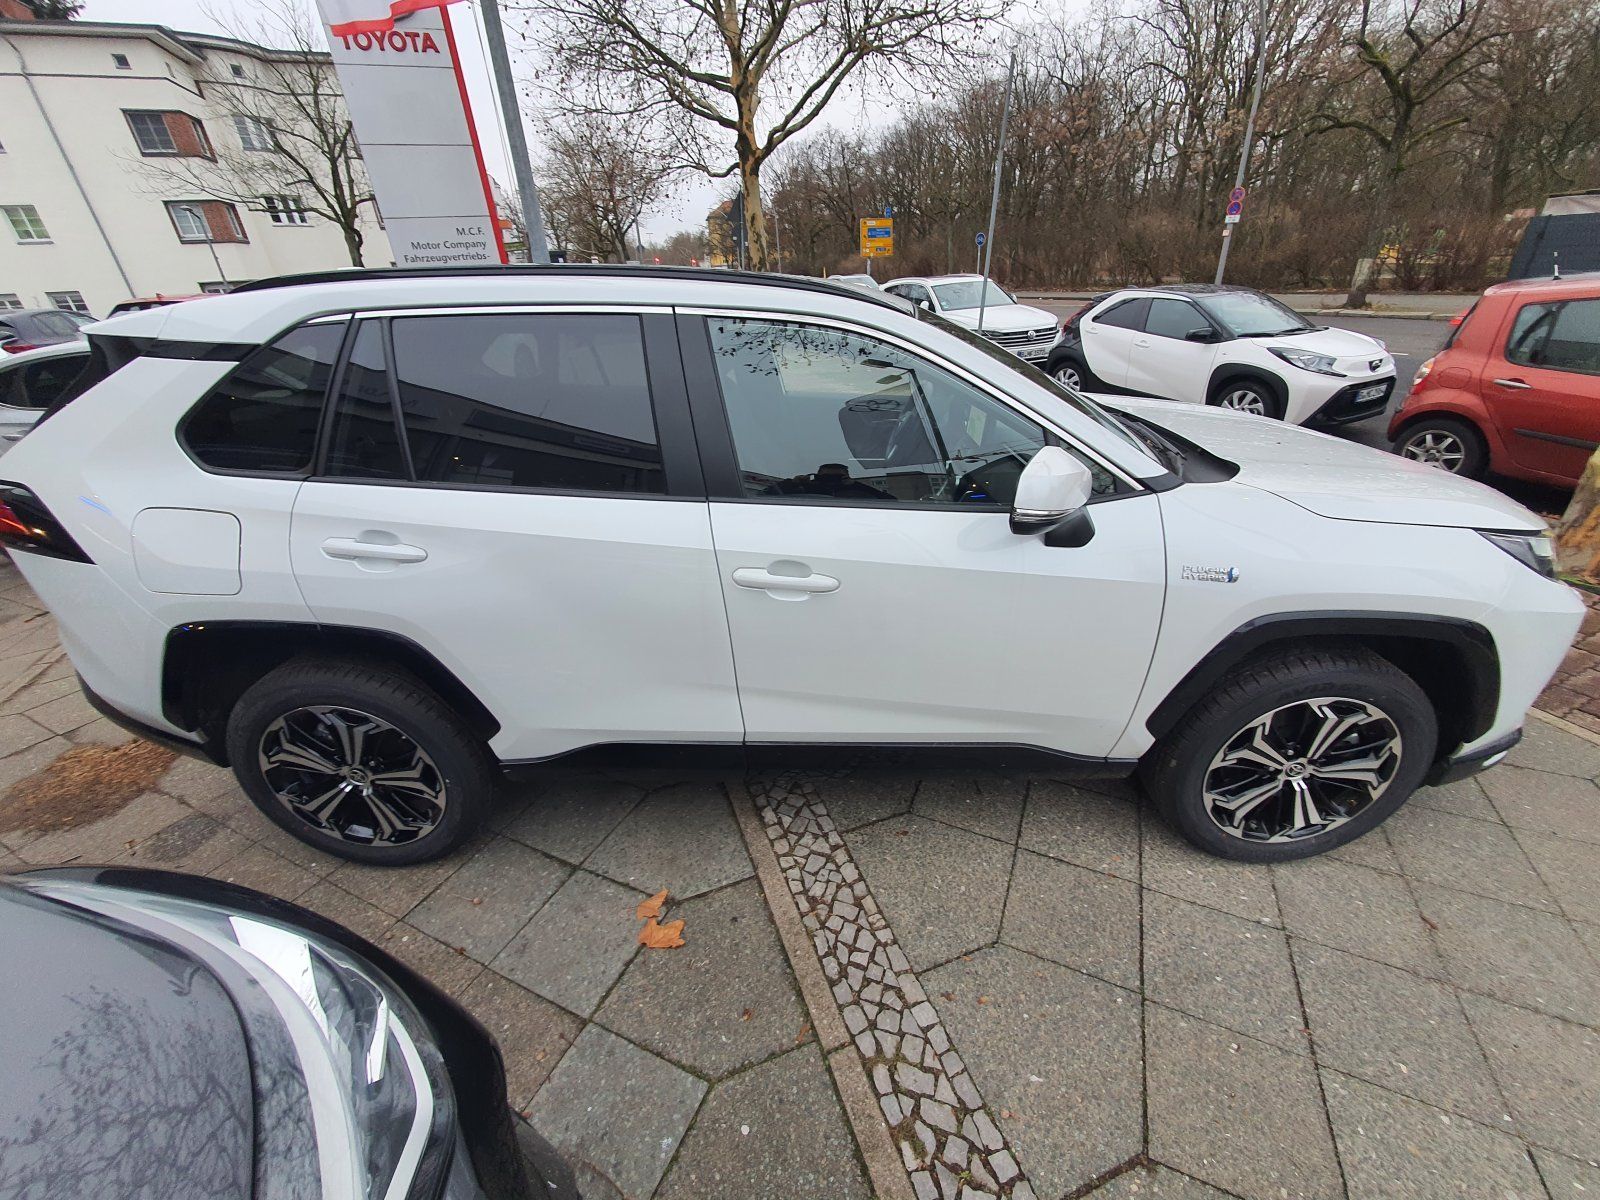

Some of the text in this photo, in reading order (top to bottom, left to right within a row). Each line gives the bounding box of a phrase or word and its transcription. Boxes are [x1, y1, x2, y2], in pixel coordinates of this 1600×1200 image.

[456, 227, 485, 236] M.C.F.
[411, 241, 486, 250] Motor Company
[404, 252, 491, 263] Fahrzeugvertriebs-
[1181, 573, 1228, 582] HYBRID
